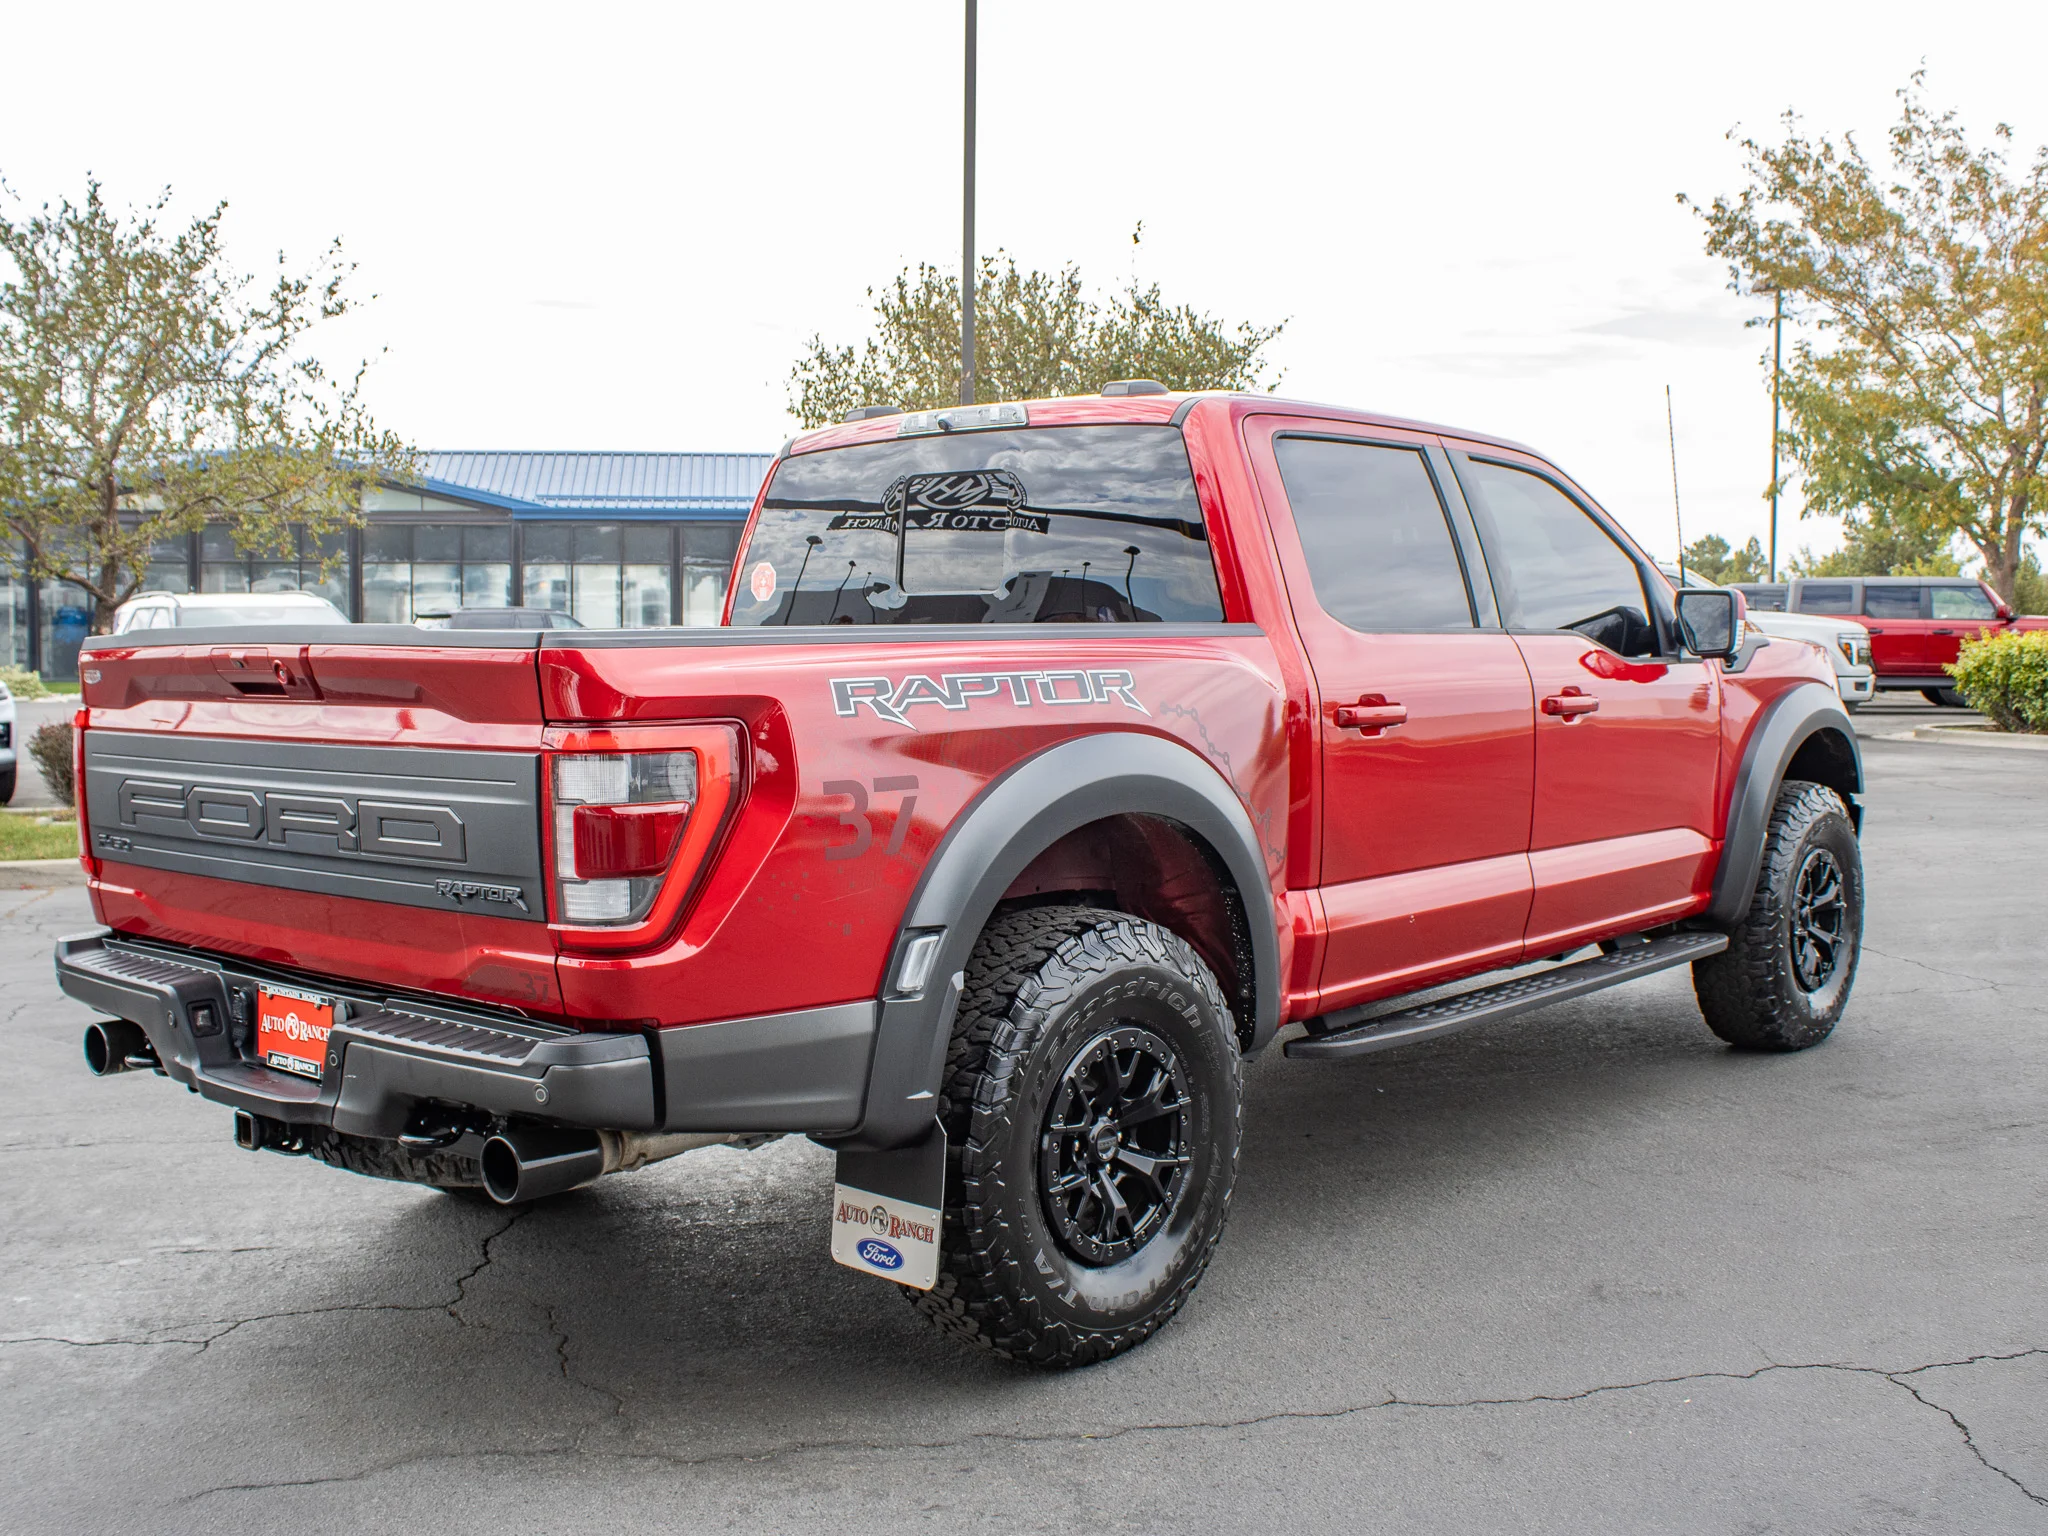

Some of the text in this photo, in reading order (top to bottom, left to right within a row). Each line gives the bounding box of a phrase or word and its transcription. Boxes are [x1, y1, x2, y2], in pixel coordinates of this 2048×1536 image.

[829, 669, 1152, 731] RAPTOR
[118, 778, 466, 862] FORD
[822, 773, 919, 861] 37
[435, 878, 531, 914] RAPTOR
[519, 972, 549, 1004] 37
[260, 1013, 331, 1042] AUTO RANCH
[835, 1200, 935, 1244] AUTO RANCH
[862, 1242, 898, 1268] Ford
